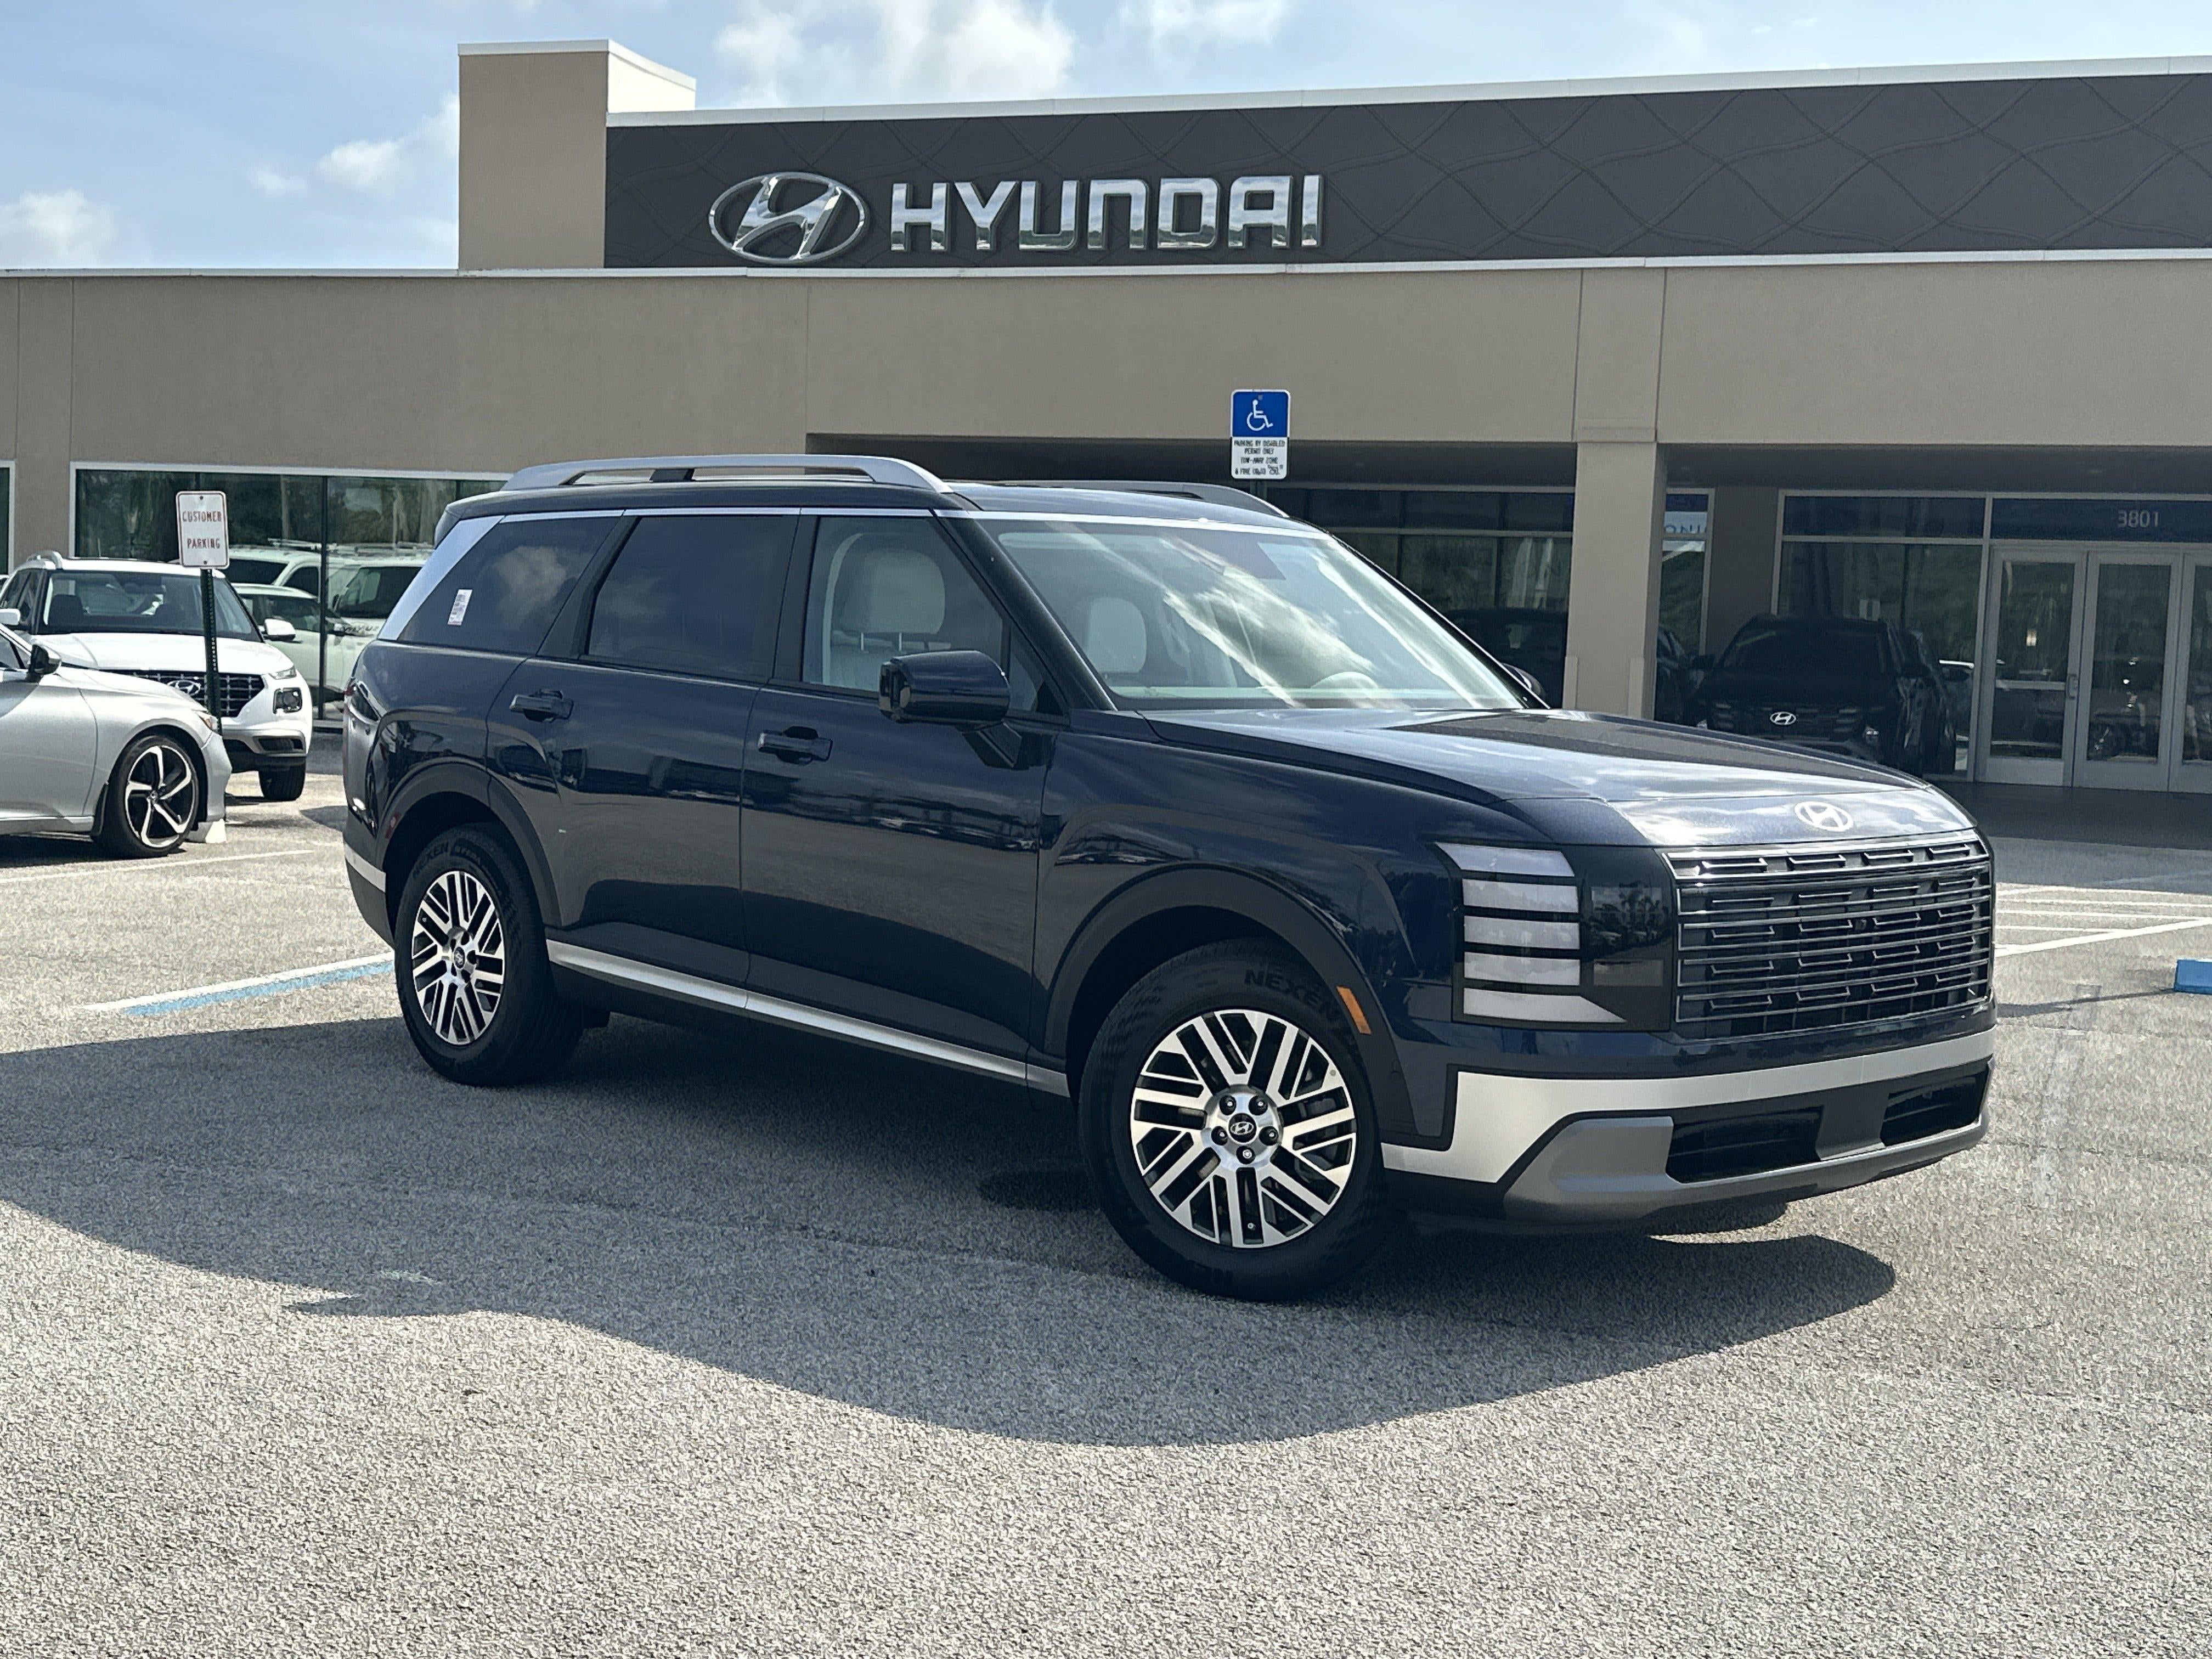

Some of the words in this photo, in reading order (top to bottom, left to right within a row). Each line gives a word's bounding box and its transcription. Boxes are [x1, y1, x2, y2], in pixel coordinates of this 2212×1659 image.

[890, 174, 1323, 251] HYUNDAI
[182, 511, 222, 522] CUSTOMER
[2118, 509, 2159, 528] 3801
[187, 538, 221, 549] PARKING
[1244, 968, 1341, 1022] NEXEN
